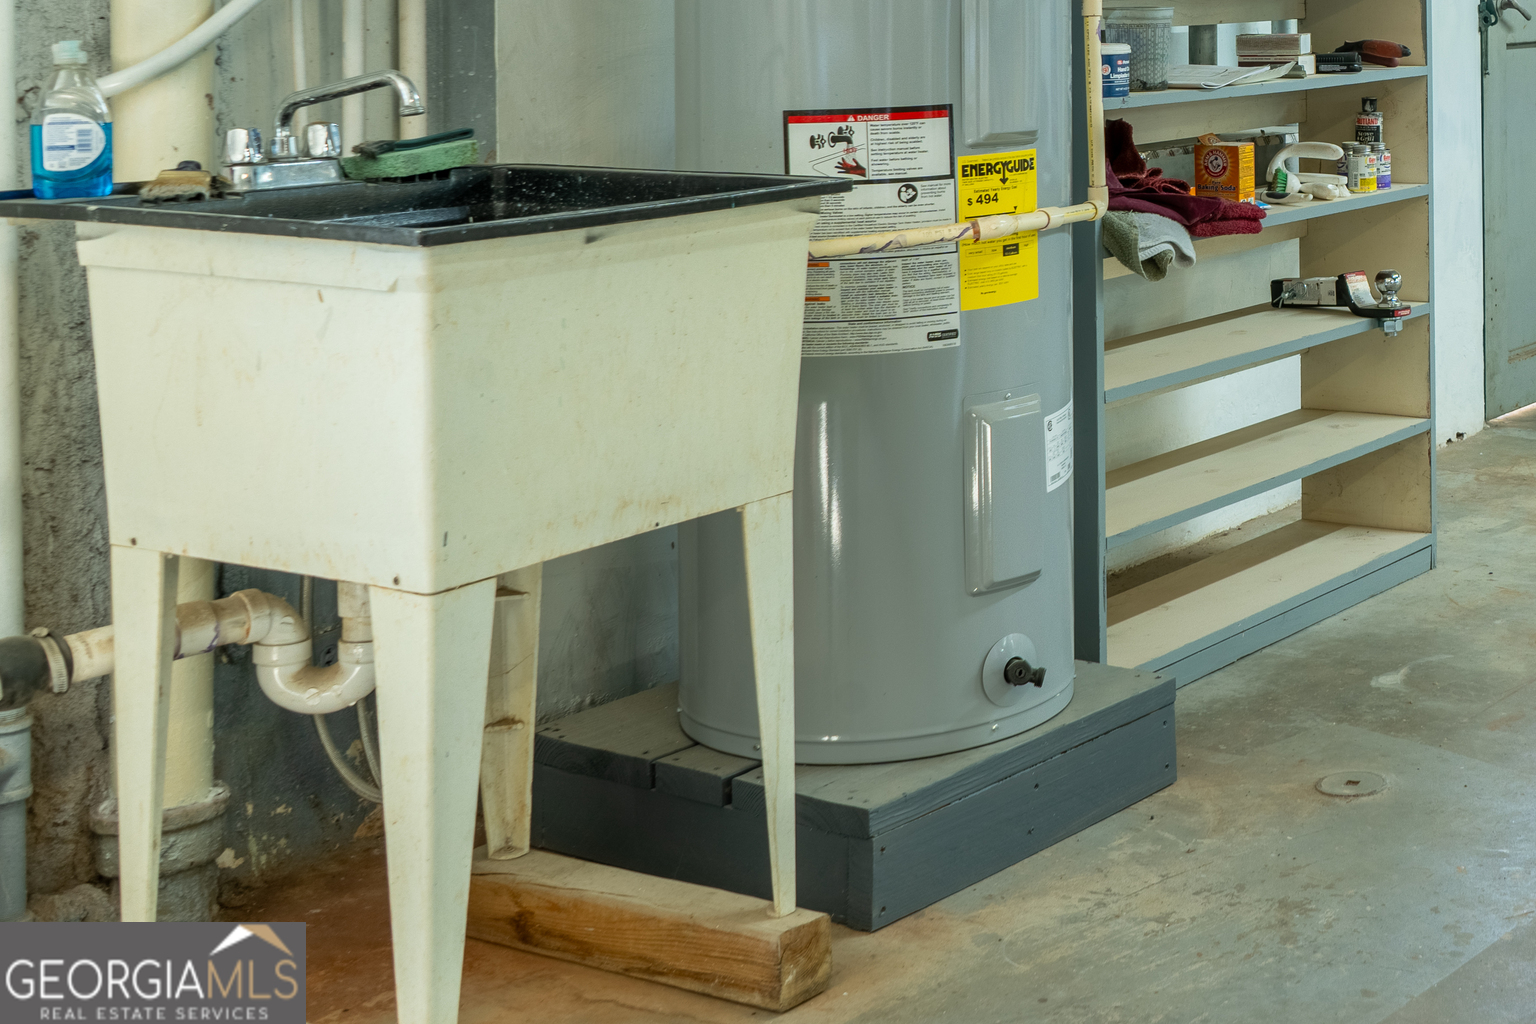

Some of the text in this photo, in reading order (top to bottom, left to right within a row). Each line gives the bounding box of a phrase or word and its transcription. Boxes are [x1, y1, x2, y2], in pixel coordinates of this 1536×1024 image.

[962, 157, 1034, 177] ENERGYGUIDE
[967, 192, 998, 206] $ 494
